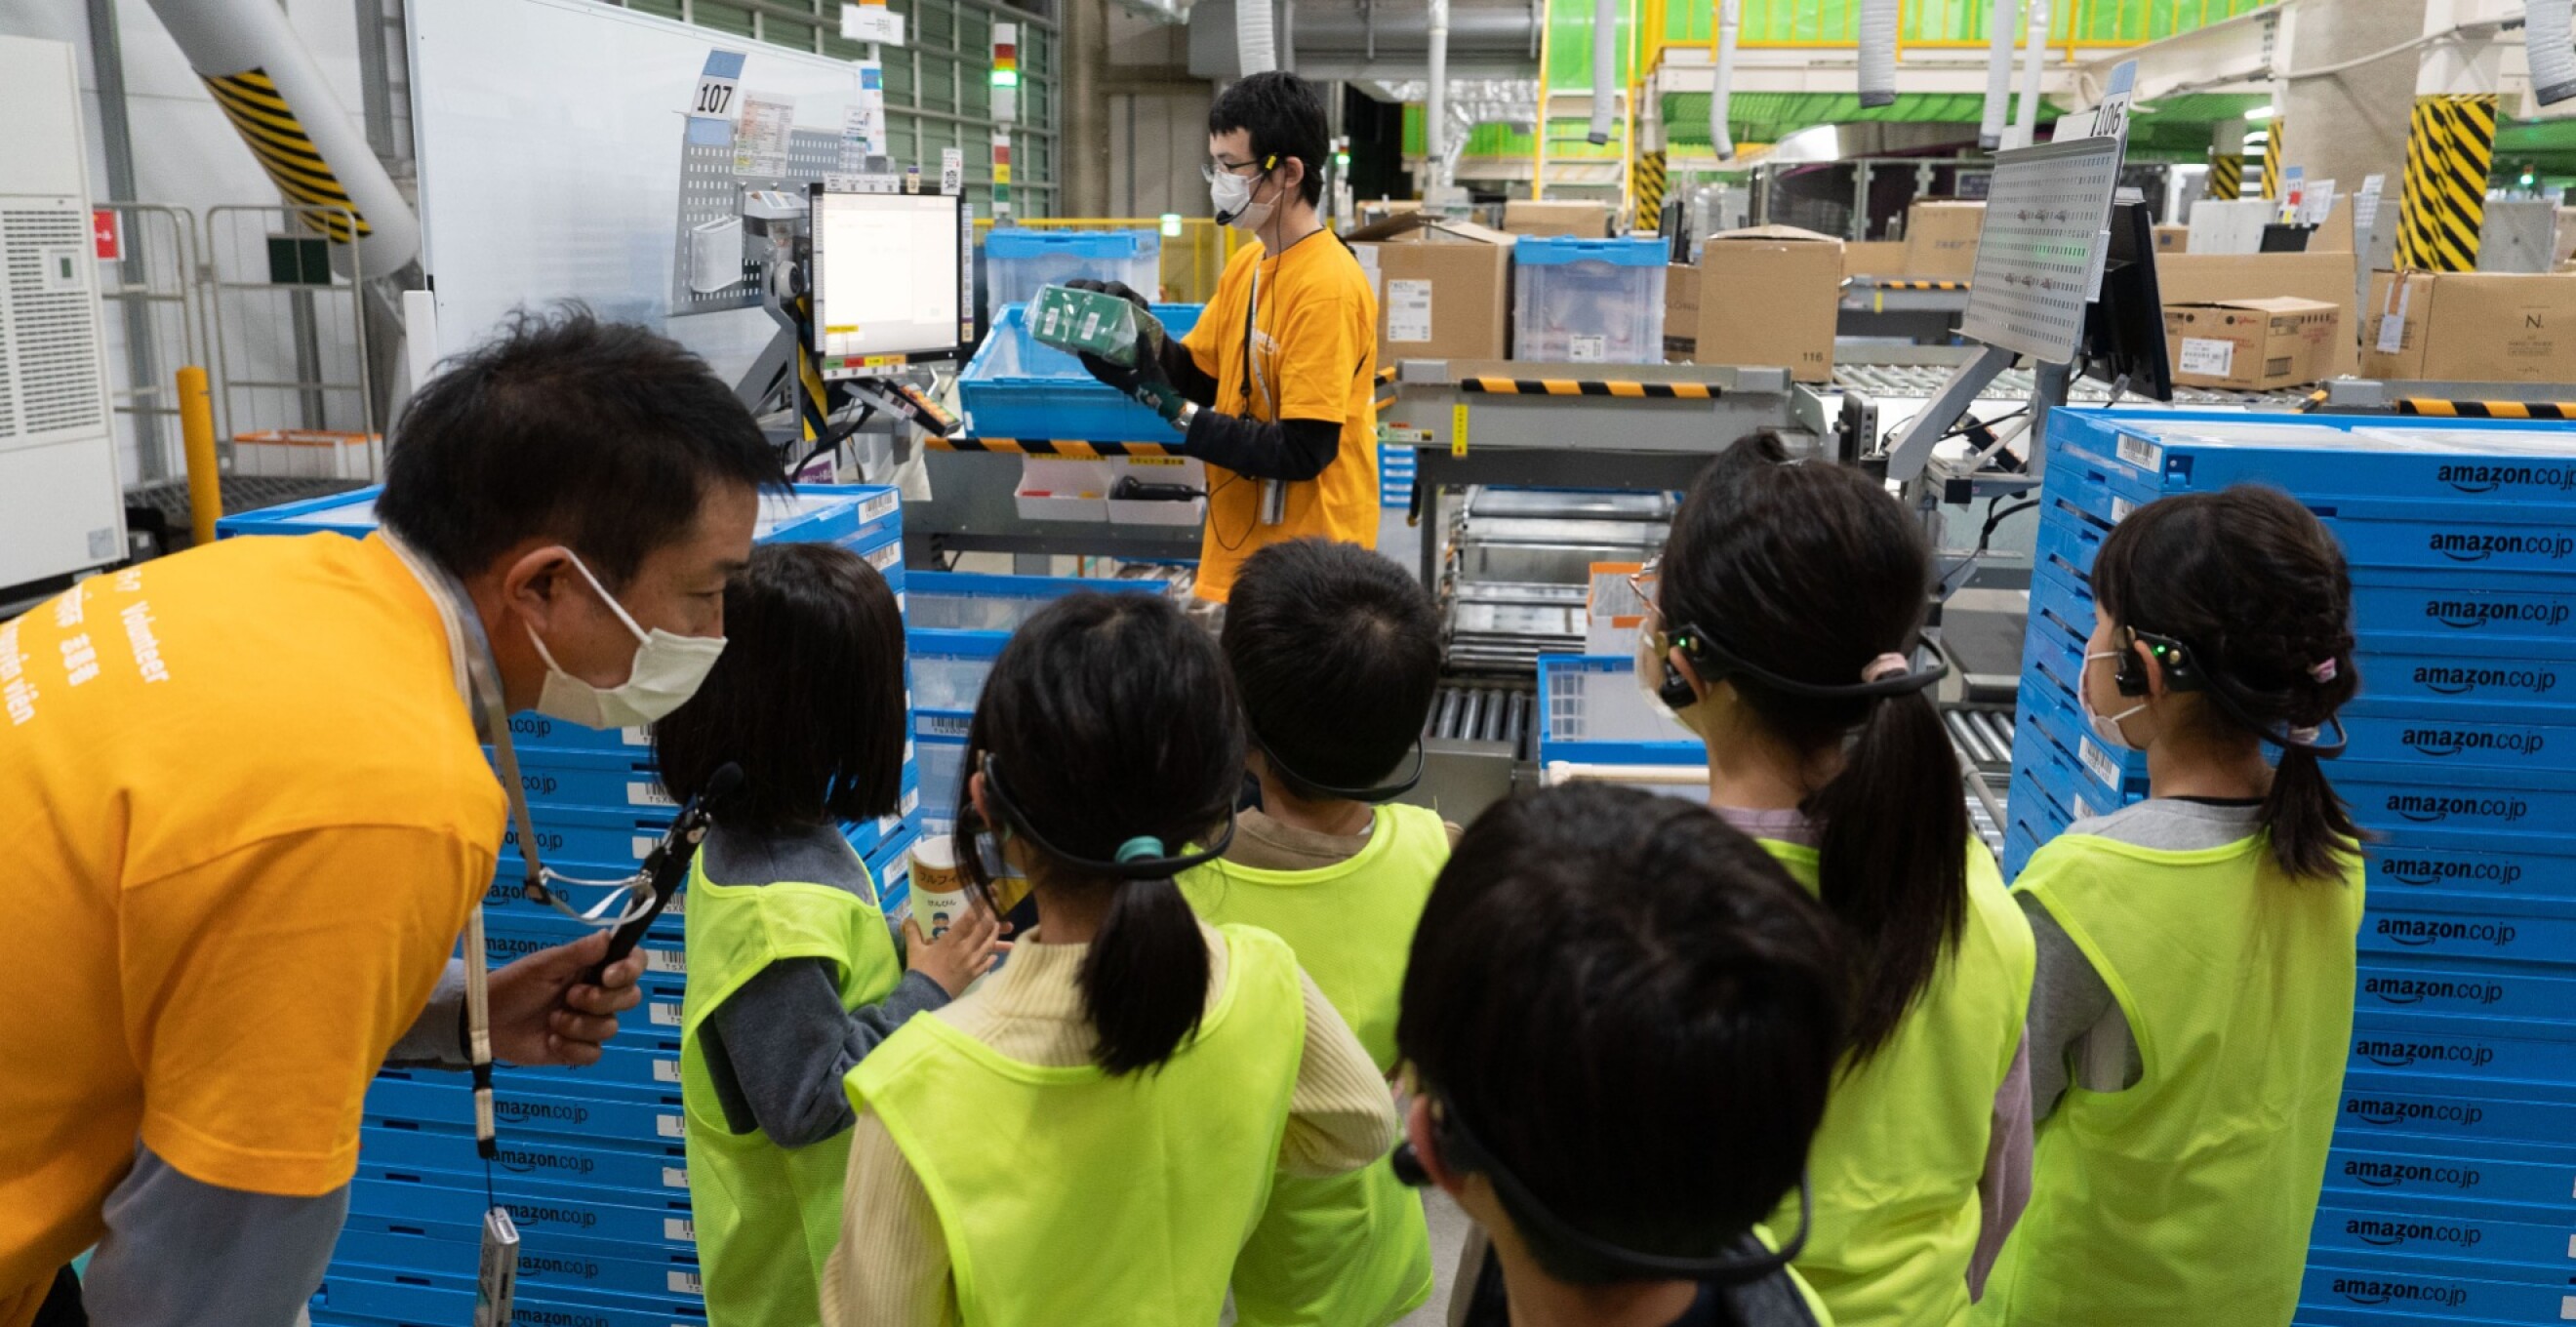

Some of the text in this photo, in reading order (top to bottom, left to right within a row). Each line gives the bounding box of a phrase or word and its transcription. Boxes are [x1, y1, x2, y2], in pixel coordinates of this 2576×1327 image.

[697, 83, 734, 114] 107
[2097, 101, 2124, 136] 106
[2429, 532, 2574, 560] amazon.co.jp
[2425, 598, 2570, 624] amazon.co.jp
[120, 600, 170, 684] Volunteer
[2413, 663, 2556, 691] amazon.co.jp
[2401, 726, 2545, 752] amazon.co.jp
[2386, 793, 2527, 822] amazon.co.jp
[2381, 858, 2521, 885] amazon.co.jp
[2376, 918, 2516, 945] amazon.co.jp
[2364, 978, 2504, 1004] amazon.co.jp
[2355, 1039, 2495, 1065] amazon.co.jp
[495, 1100, 588, 1125] mazon.co.jp
[2346, 1098, 2484, 1125] amazon.co.jp
[2344, 1160, 2480, 1186] amazon.co.jp
[494, 1203, 597, 1228] mazon.co.jp
[2345, 1219, 2482, 1245] amazon.co.jp
[517, 1256, 599, 1279] azon.co.jp
[2332, 1278, 2469, 1305] amazon.co.jp
